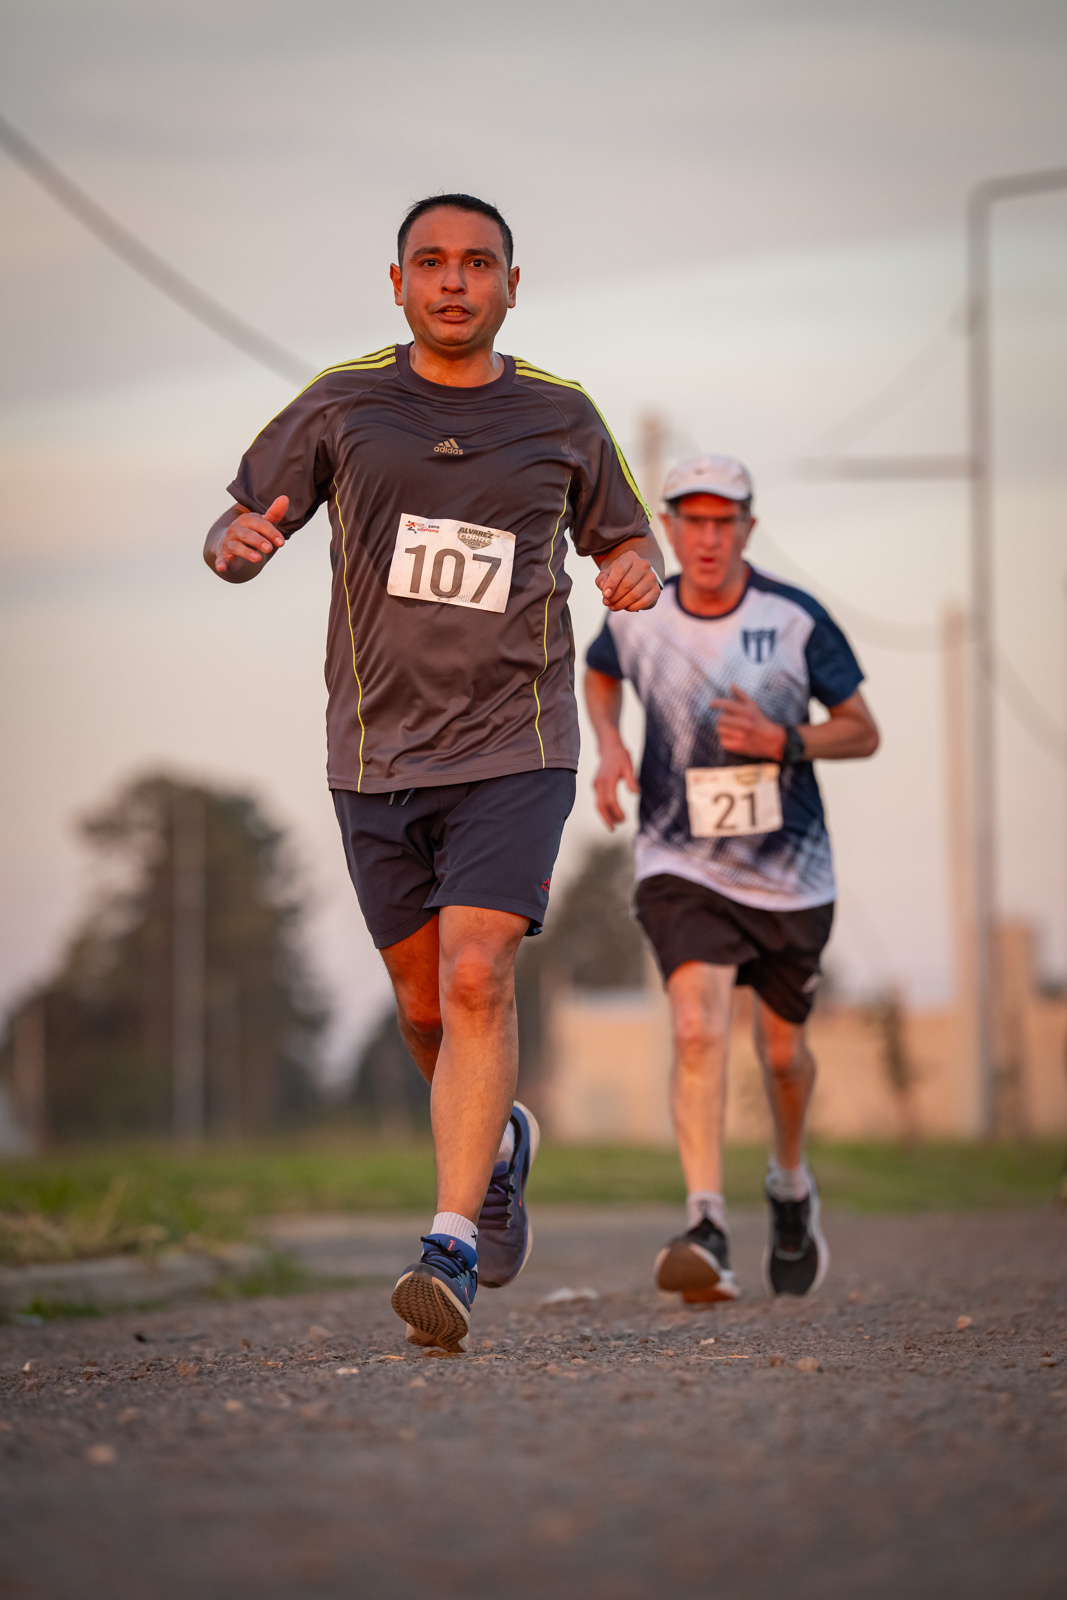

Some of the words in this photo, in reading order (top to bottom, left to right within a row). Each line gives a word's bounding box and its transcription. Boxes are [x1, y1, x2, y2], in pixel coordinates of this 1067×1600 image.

[433, 445, 464, 455] adidas
[458, 527, 493, 539] ALVAREZ
[459, 533, 491, 544] CORRE
[404, 544, 502, 604] 107
[713, 791, 756, 830] 21
